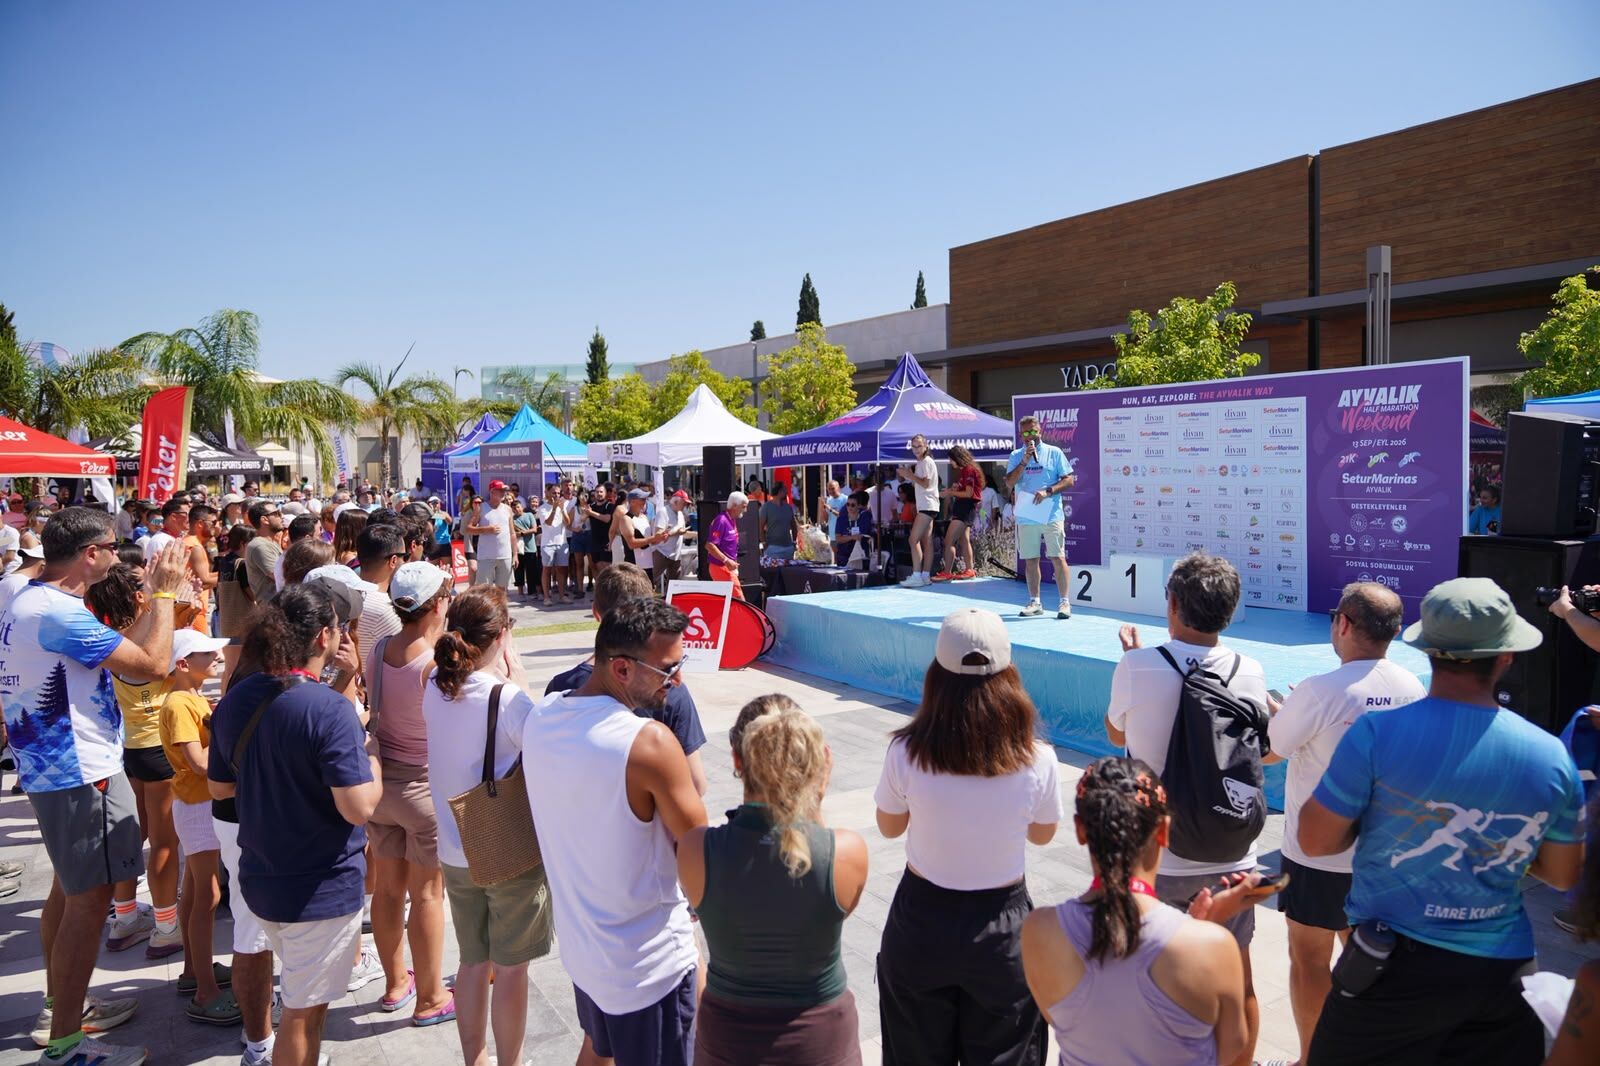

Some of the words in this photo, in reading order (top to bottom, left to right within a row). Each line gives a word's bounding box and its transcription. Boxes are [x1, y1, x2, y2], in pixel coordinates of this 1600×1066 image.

[1122, 396, 1140, 405] RUN,
[1142, 395, 1157, 404] EAT,
[1159, 393, 1197, 403] EXPLORE:
[1199, 391, 1214, 400] THE
[1216, 388, 1253, 399] AYVALIK
[1254, 386, 1274, 395] WAY
[1337, 384, 1422, 407] AYVALIK
[1224, 408, 1247, 418] divan
[1363, 405, 1380, 413] HALF
[1380, 403, 1419, 412] MARATHON
[1033, 408, 1079, 423] AYVALIK
[1341, 401, 1416, 434] Weekend
[1183, 428, 1204, 438] divan
[1269, 425, 1293, 435] divan
[612, 443, 634, 455] STB
[906, 439, 954, 450] VALIK
[960, 439, 985, 450] HALF
[988, 438, 1013, 450] MAR
[1224, 444, 1247, 454] divan
[1352, 441, 1359, 449] 13
[1360, 439, 1372, 447] SEP
[1390, 438, 1407, 446] 2026
[772, 444, 798, 458] AYVALIK
[799, 443, 816, 455] HALF
[817, 441, 862, 454] MARATHON
[1341, 453, 1356, 464] 21K
[222, 461, 242, 470] SPORTS
[242, 461, 261, 470] EVENTS
[1342, 472, 1418, 484] SeturMarinas
[1351, 503, 1407, 511] DESTEKLEYENLER
[1345, 560, 1369, 568] SOSYAL
[1369, 562, 1414, 571] SORUMLULUK
[1077, 570, 1093, 602] 2
[1125, 563, 1136, 598] 1
[1366, 697, 1391, 706] RUN
[1424, 903, 1467, 920] EMRE
[1468, 903, 1507, 920] KURT
